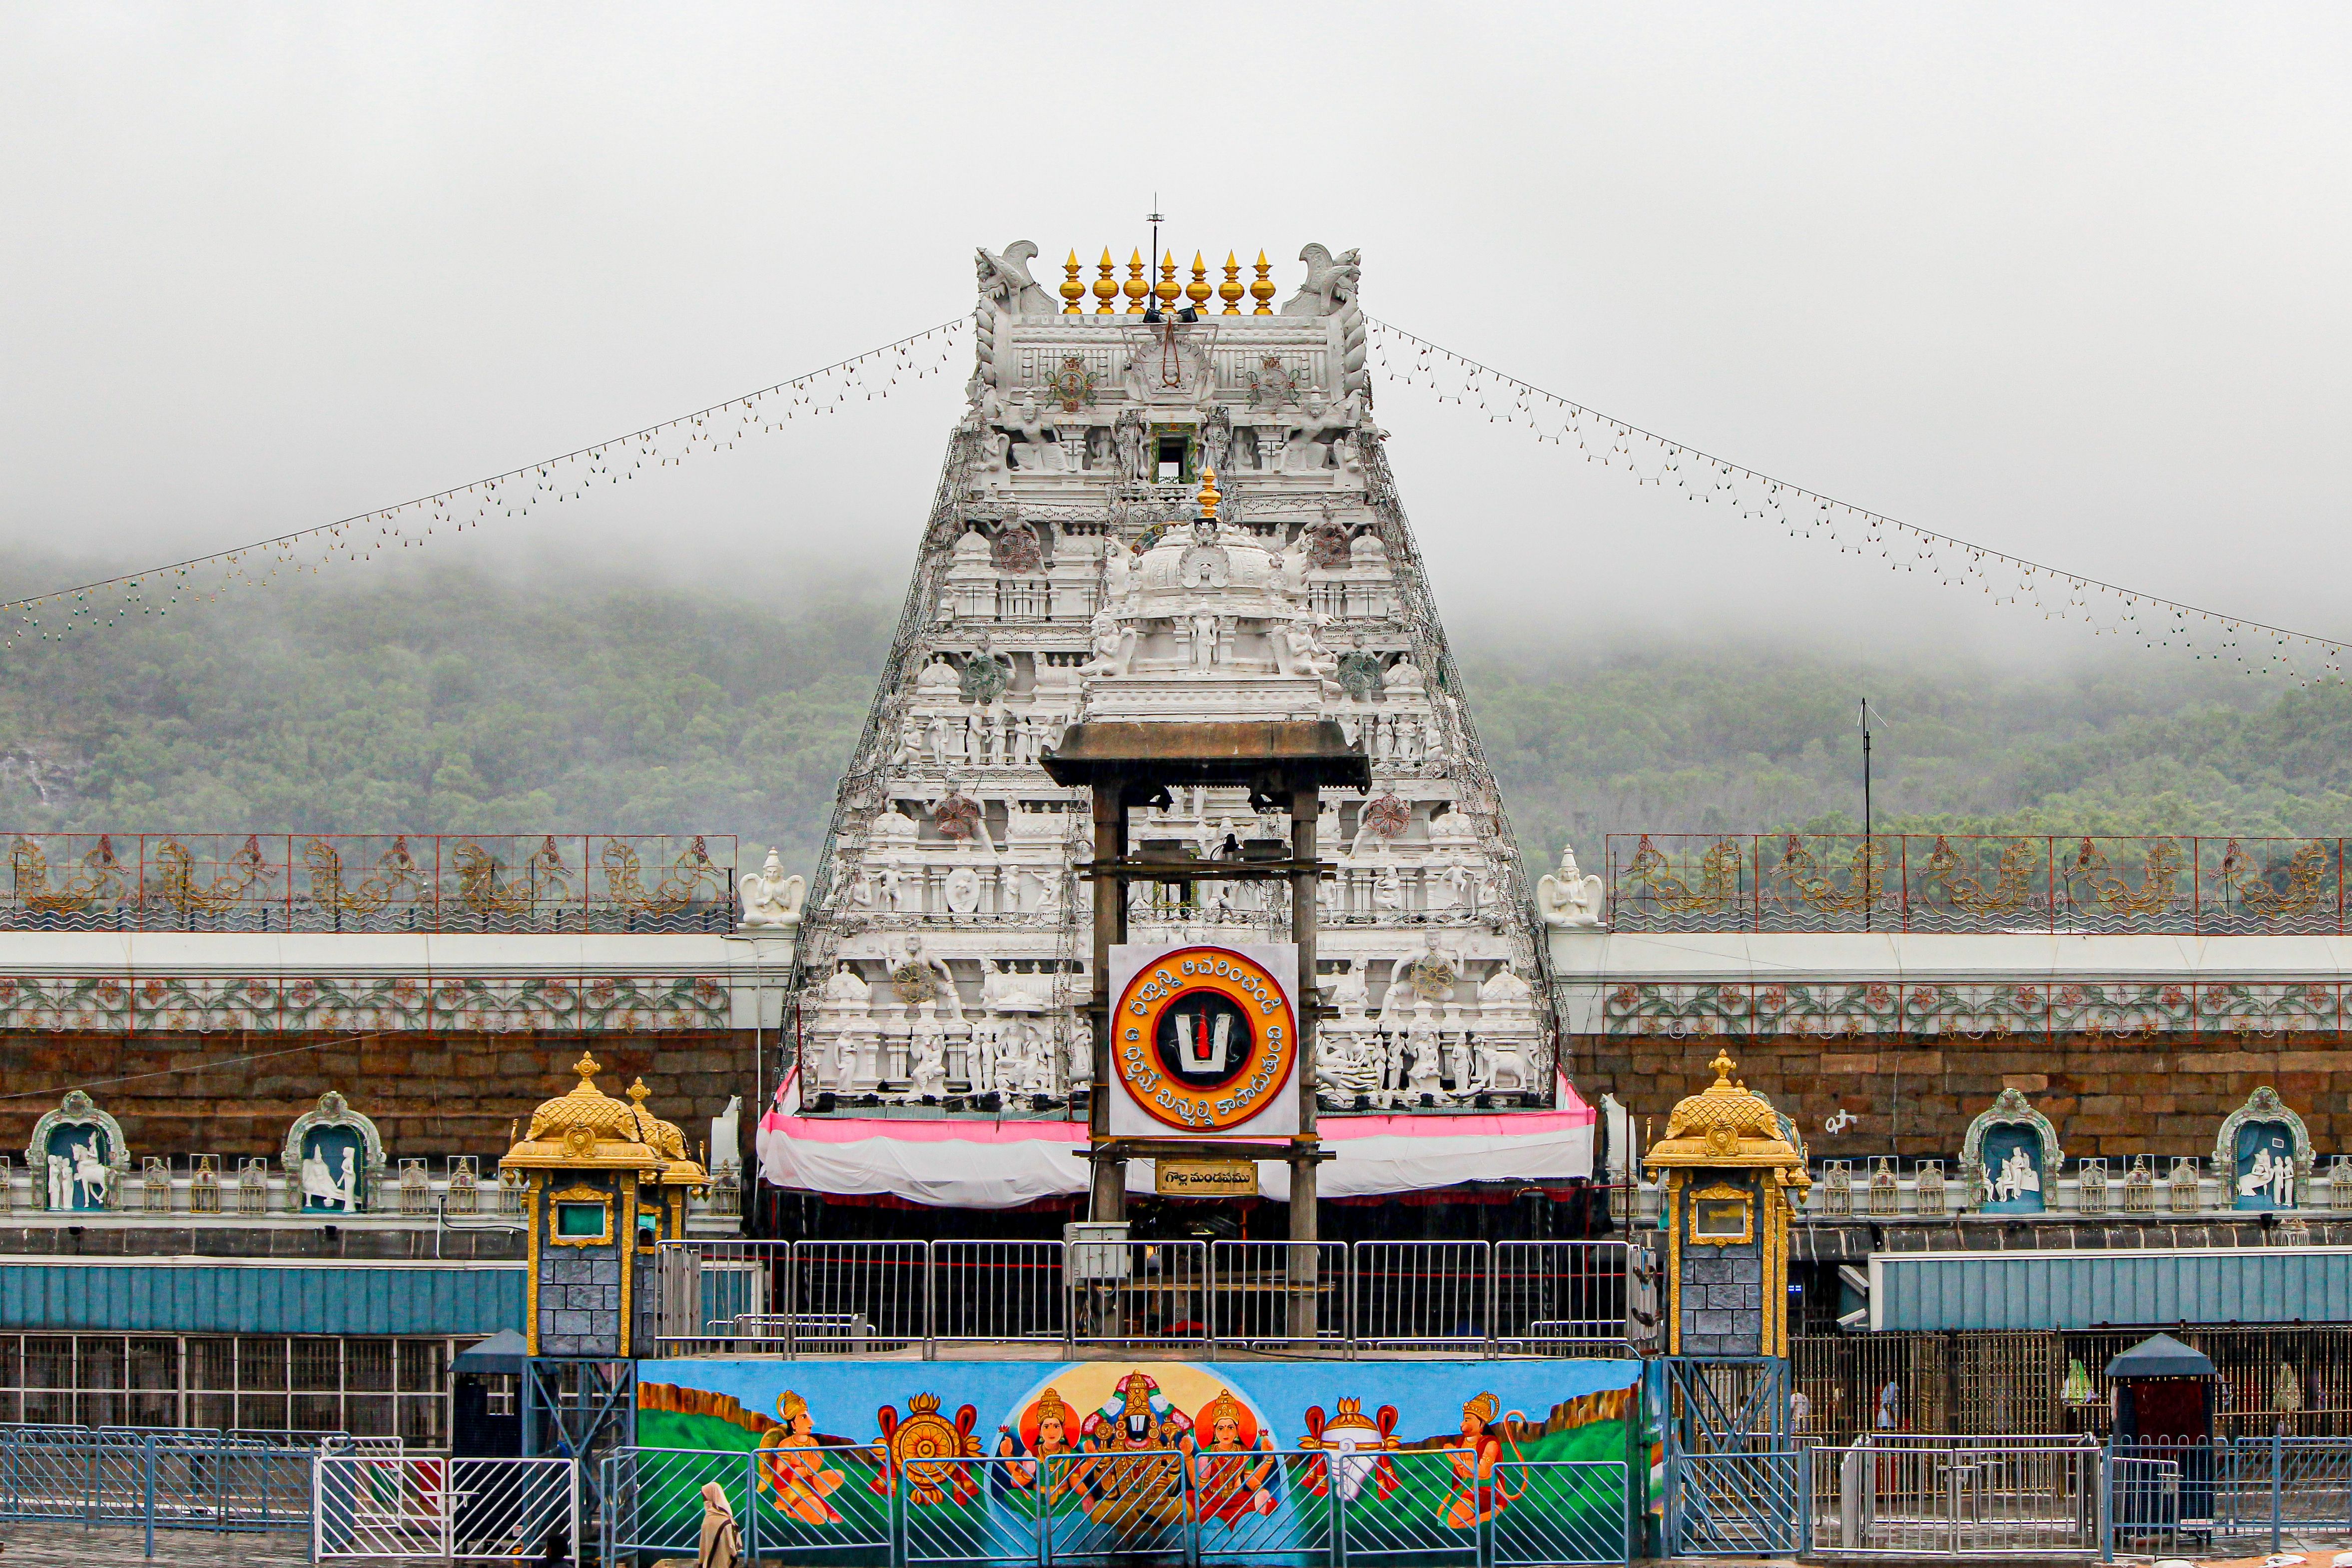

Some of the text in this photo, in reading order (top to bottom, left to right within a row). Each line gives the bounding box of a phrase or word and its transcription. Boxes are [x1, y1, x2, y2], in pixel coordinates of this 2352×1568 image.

[1129, 956, 1282, 1016] ధర్మాన్ని ఆచరించండి
[1125, 1028, 1140, 1041] ఆ
[1156, 1088, 1214, 1126] మిమ్మల్ని
[1215, 1026, 1282, 1115] కాపాడుతుంది
[1165, 1171, 1250, 1186] గొల్ల మండపము
